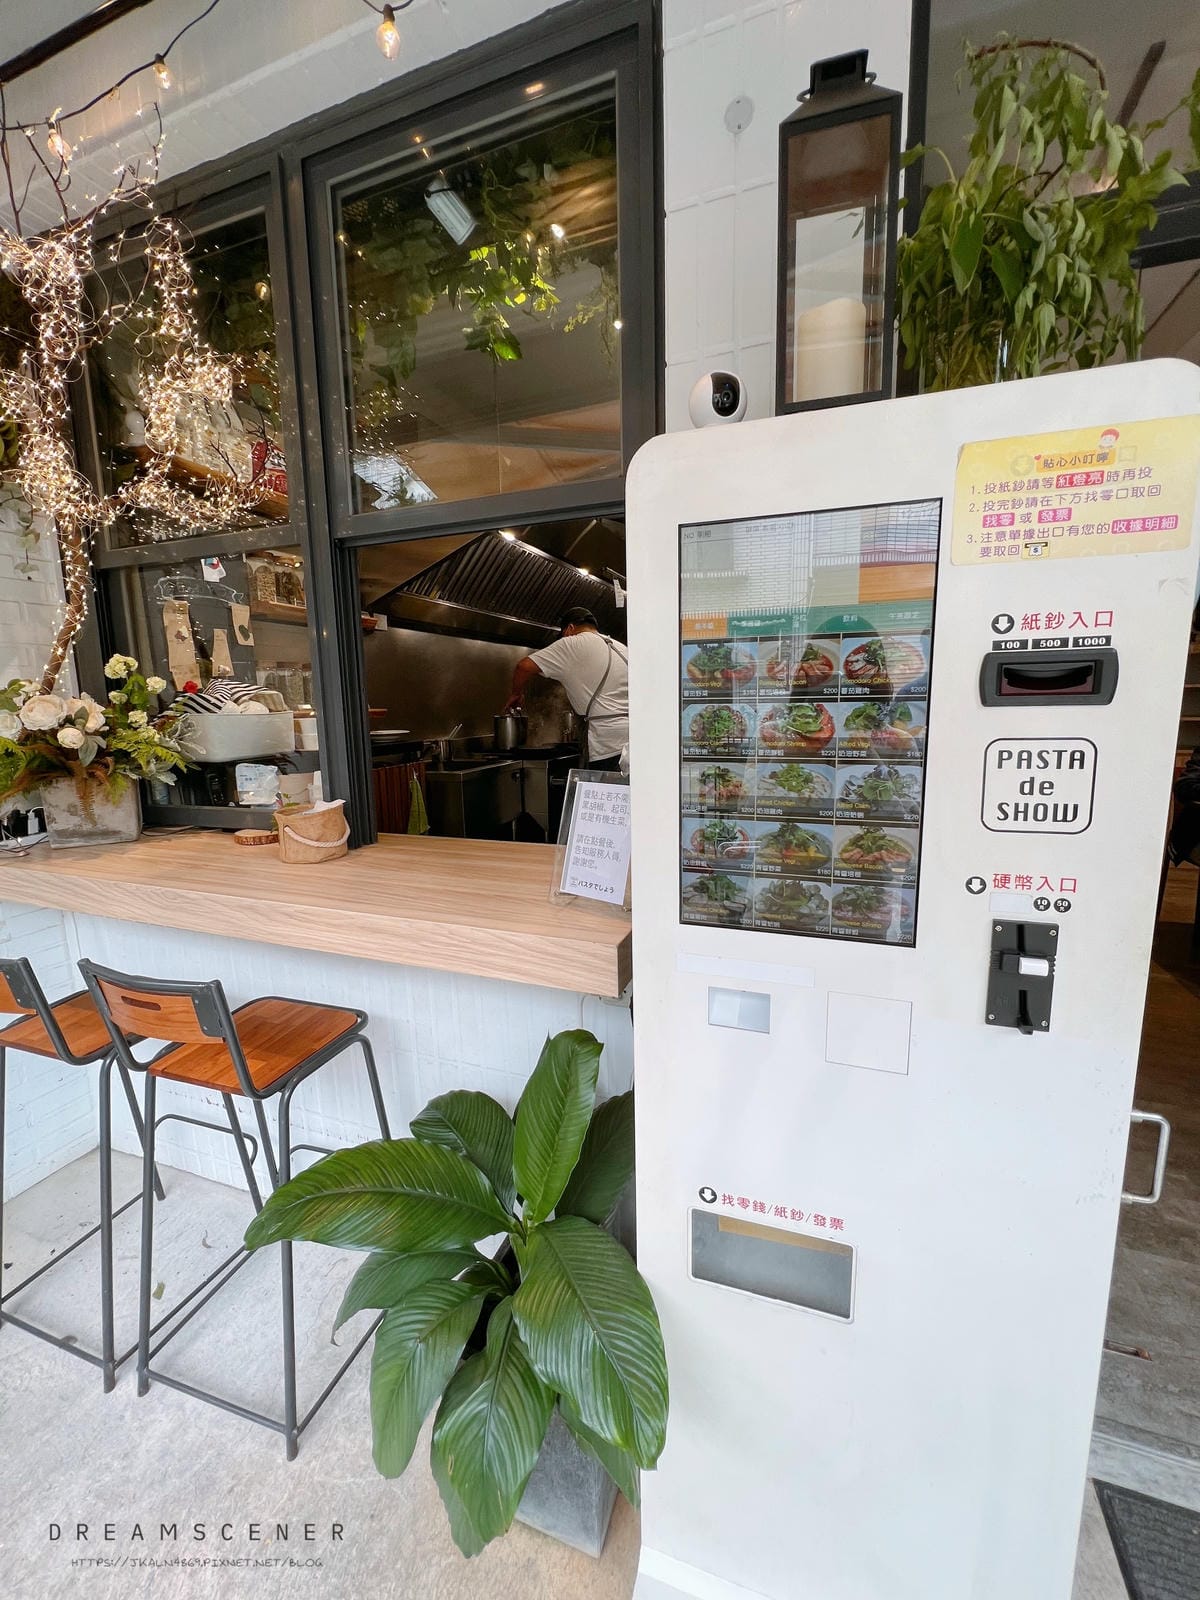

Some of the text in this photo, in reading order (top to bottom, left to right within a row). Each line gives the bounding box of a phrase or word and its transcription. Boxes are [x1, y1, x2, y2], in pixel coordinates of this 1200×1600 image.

[1043, 452, 1109, 469] 貼心小叮嚀
[979, 544, 1019, 558] 要取回
[1021, 611, 1113, 631] 紙鈔入口
[1000, 641, 1020, 649] 100
[1078, 637, 1106, 645] 1000
[997, 750, 1085, 769] PASTA
[1019, 777, 1054, 795] de
[997, 802, 1078, 822] SHOW
[992, 873, 1077, 893] 硬幣入口
[721, 1193, 844, 1231] 找零錢/紙鈔/發票
